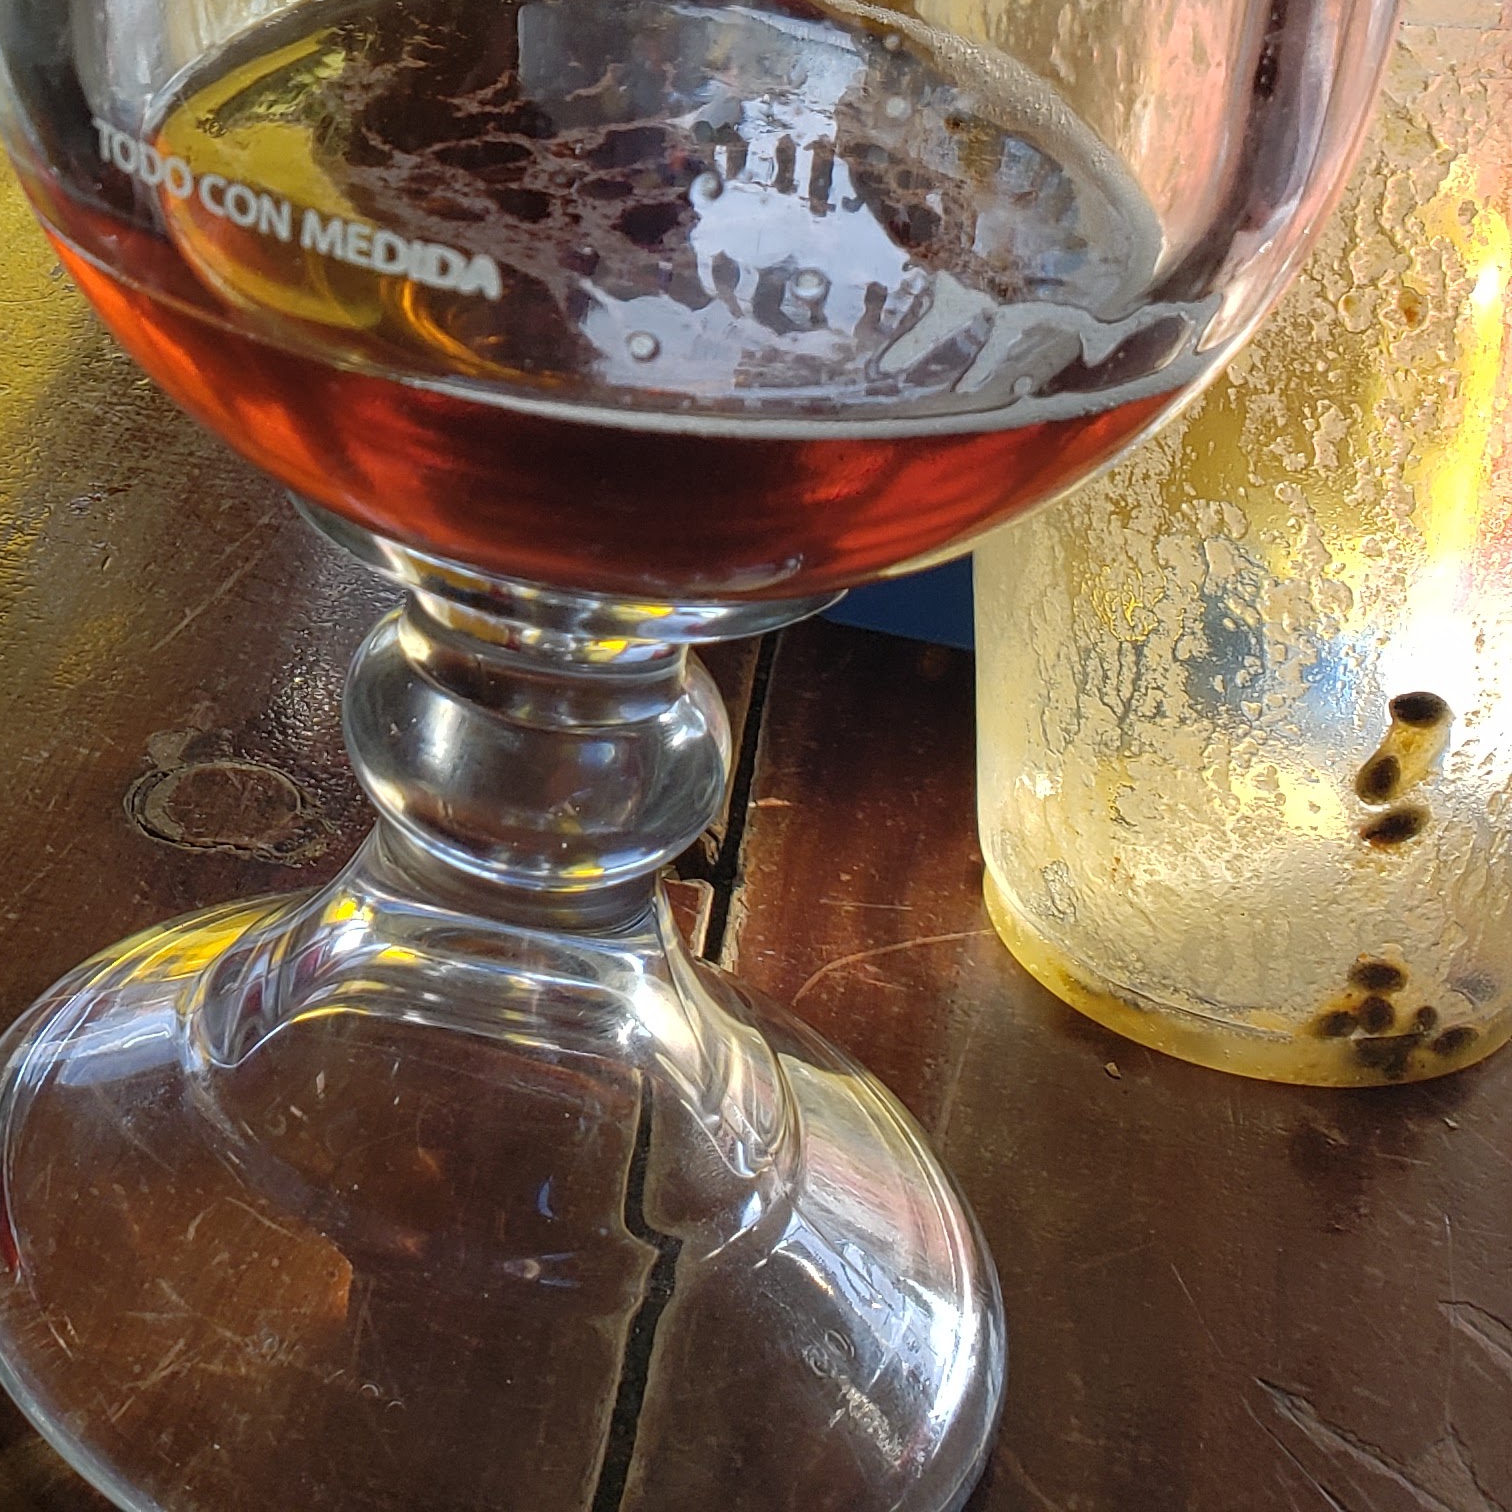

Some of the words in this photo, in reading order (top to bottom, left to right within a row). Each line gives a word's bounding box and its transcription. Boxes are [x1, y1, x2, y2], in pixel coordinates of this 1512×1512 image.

[93, 118, 194, 199] TODO
[197, 172, 293, 242] CON
[299, 207, 504, 302] MEDIDA
